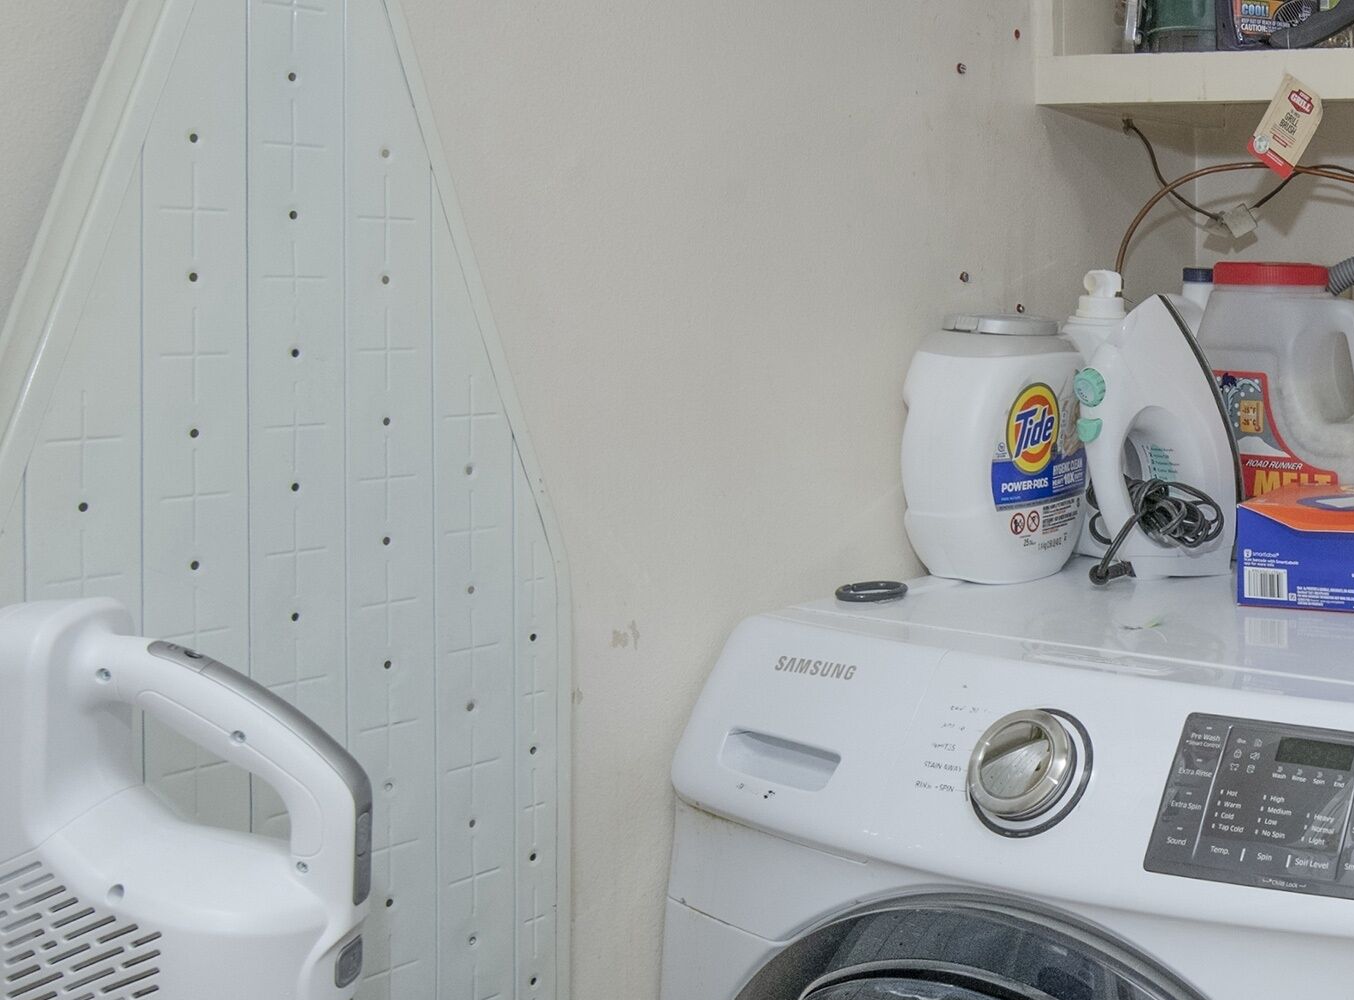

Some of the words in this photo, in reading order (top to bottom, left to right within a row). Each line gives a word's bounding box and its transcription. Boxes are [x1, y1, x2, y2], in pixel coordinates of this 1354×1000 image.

[1241, 3, 1270, 17] COOL!
[1241, 23, 1267, 32] CAUTION:
[1013, 404, 1055, 461] Tide
[1245, 459, 1269, 468] ROAD
[1268, 460, 1304, 471] RUNNER
[775, 655, 857, 681] SAMSUNG
[1191, 732, 1202, 740] Pre
[1203, 732, 1221, 742] Wash
[1178, 767, 1195, 776] Extra
[1195, 768, 1213, 778] Rinse
[1226, 789, 1238, 797] Hot
[1270, 795, 1285, 803] High
[1170, 799, 1187, 809] Extra
[1187, 801, 1202, 811] Spin
[1223, 801, 1242, 809] Warm
[1220, 812, 1235, 820] Cold
[1267, 806, 1292, 816] Medium
[1264, 818, 1278, 826] Low
[1313, 814, 1335, 824] Heavy
[1218, 823, 1229, 832] Tap
[1229, 825, 1245, 833] Cold
[1311, 825, 1335, 835] Normal
[1261, 829, 1271, 837] No
[1271, 831, 1286, 839] Spin
[1166, 836, 1187, 846] Sound
[1308, 837, 1325, 846] Light
[1210, 845, 1230, 855] Temp.
[1257, 852, 1273, 862] Spin
[1295, 858, 1310, 868] Soil
[1310, 859, 1329, 869] Level
